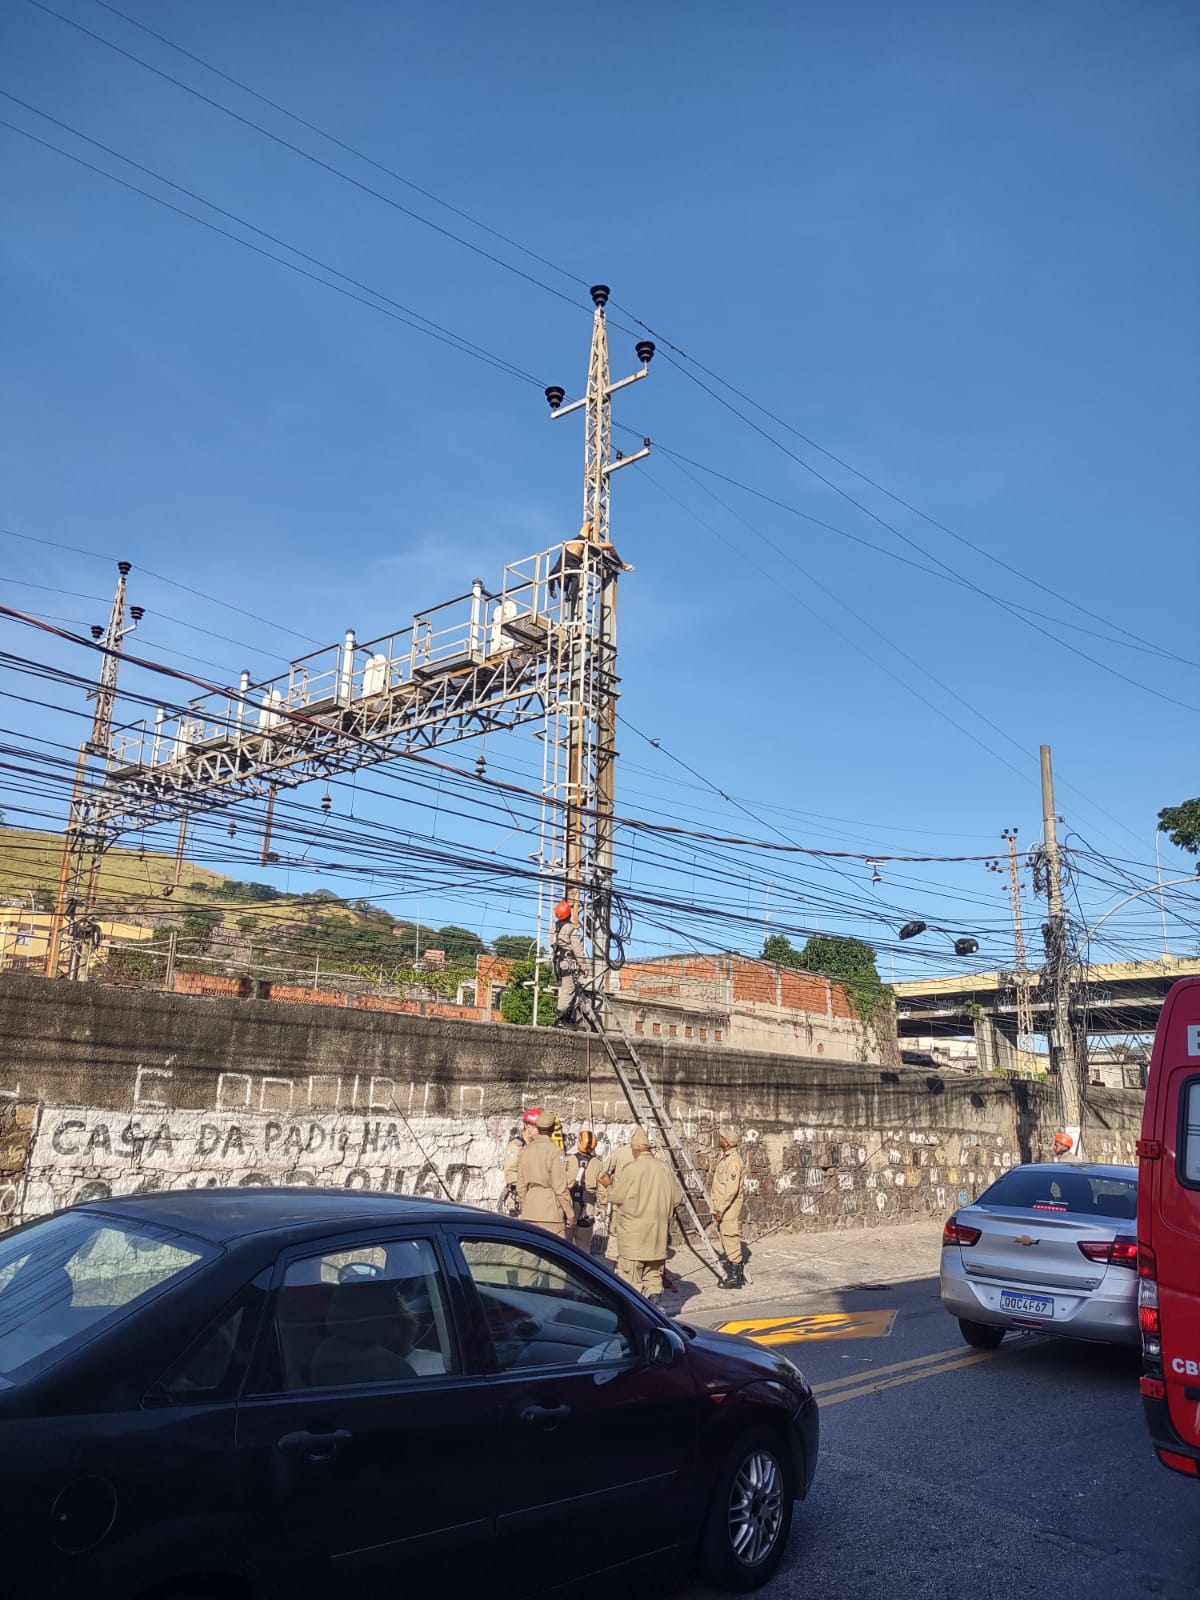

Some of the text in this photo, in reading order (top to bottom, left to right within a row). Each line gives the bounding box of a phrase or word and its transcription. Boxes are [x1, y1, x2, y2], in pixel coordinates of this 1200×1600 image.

[52, 1119, 174, 1159] CASA
[194, 1123, 245, 1158] DA
[1171, 1357, 1200, 1376] CB
